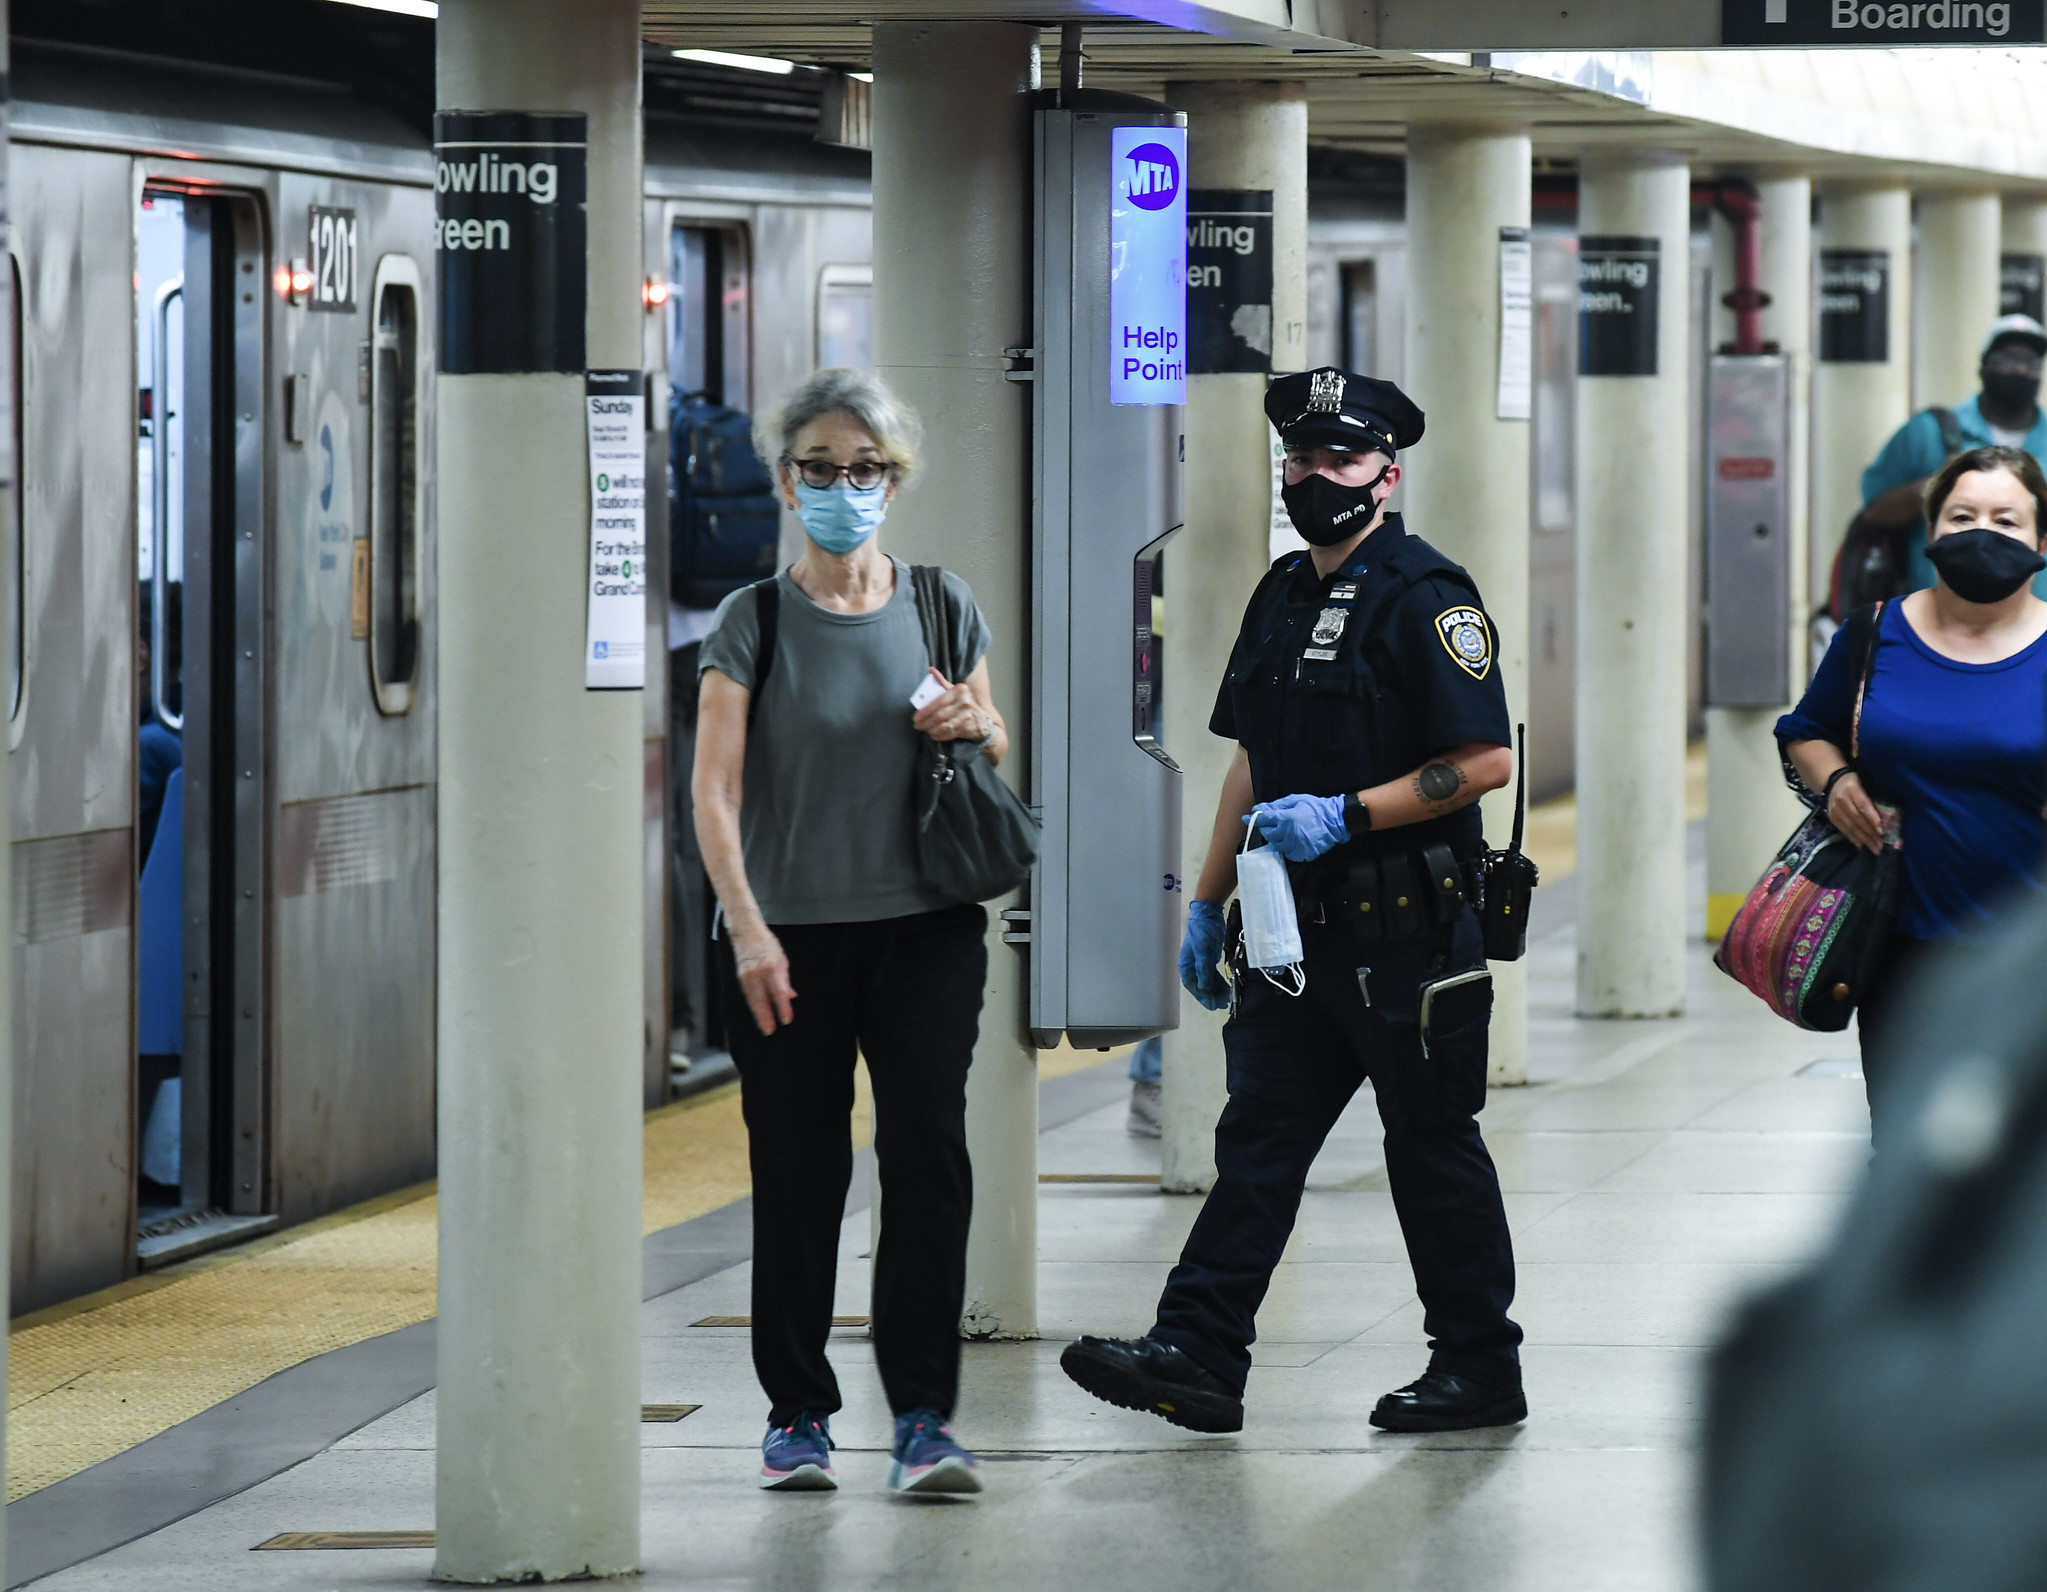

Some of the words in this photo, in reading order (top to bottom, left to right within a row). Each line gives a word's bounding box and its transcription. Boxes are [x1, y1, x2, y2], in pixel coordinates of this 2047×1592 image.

[1831, 0, 2010, 36] Boarding
[437, 153, 558, 204] owling
[1126, 158, 1175, 197] MTA
[435, 218, 510, 250] reen
[1187, 219, 1255, 255] wling
[311, 214, 358, 303] 1201
[1123, 326, 1178, 354] Help
[1123, 357, 1182, 381] Point
[592, 398, 632, 417] Sunday
[1332, 510, 1353, 525] MTA
[1354, 503, 1366, 515] PD
[596, 541, 614, 555] For
[595, 562, 619, 576] take
[593, 581, 629, 596] Grand
[1441, 611, 1483, 632] POLICE
